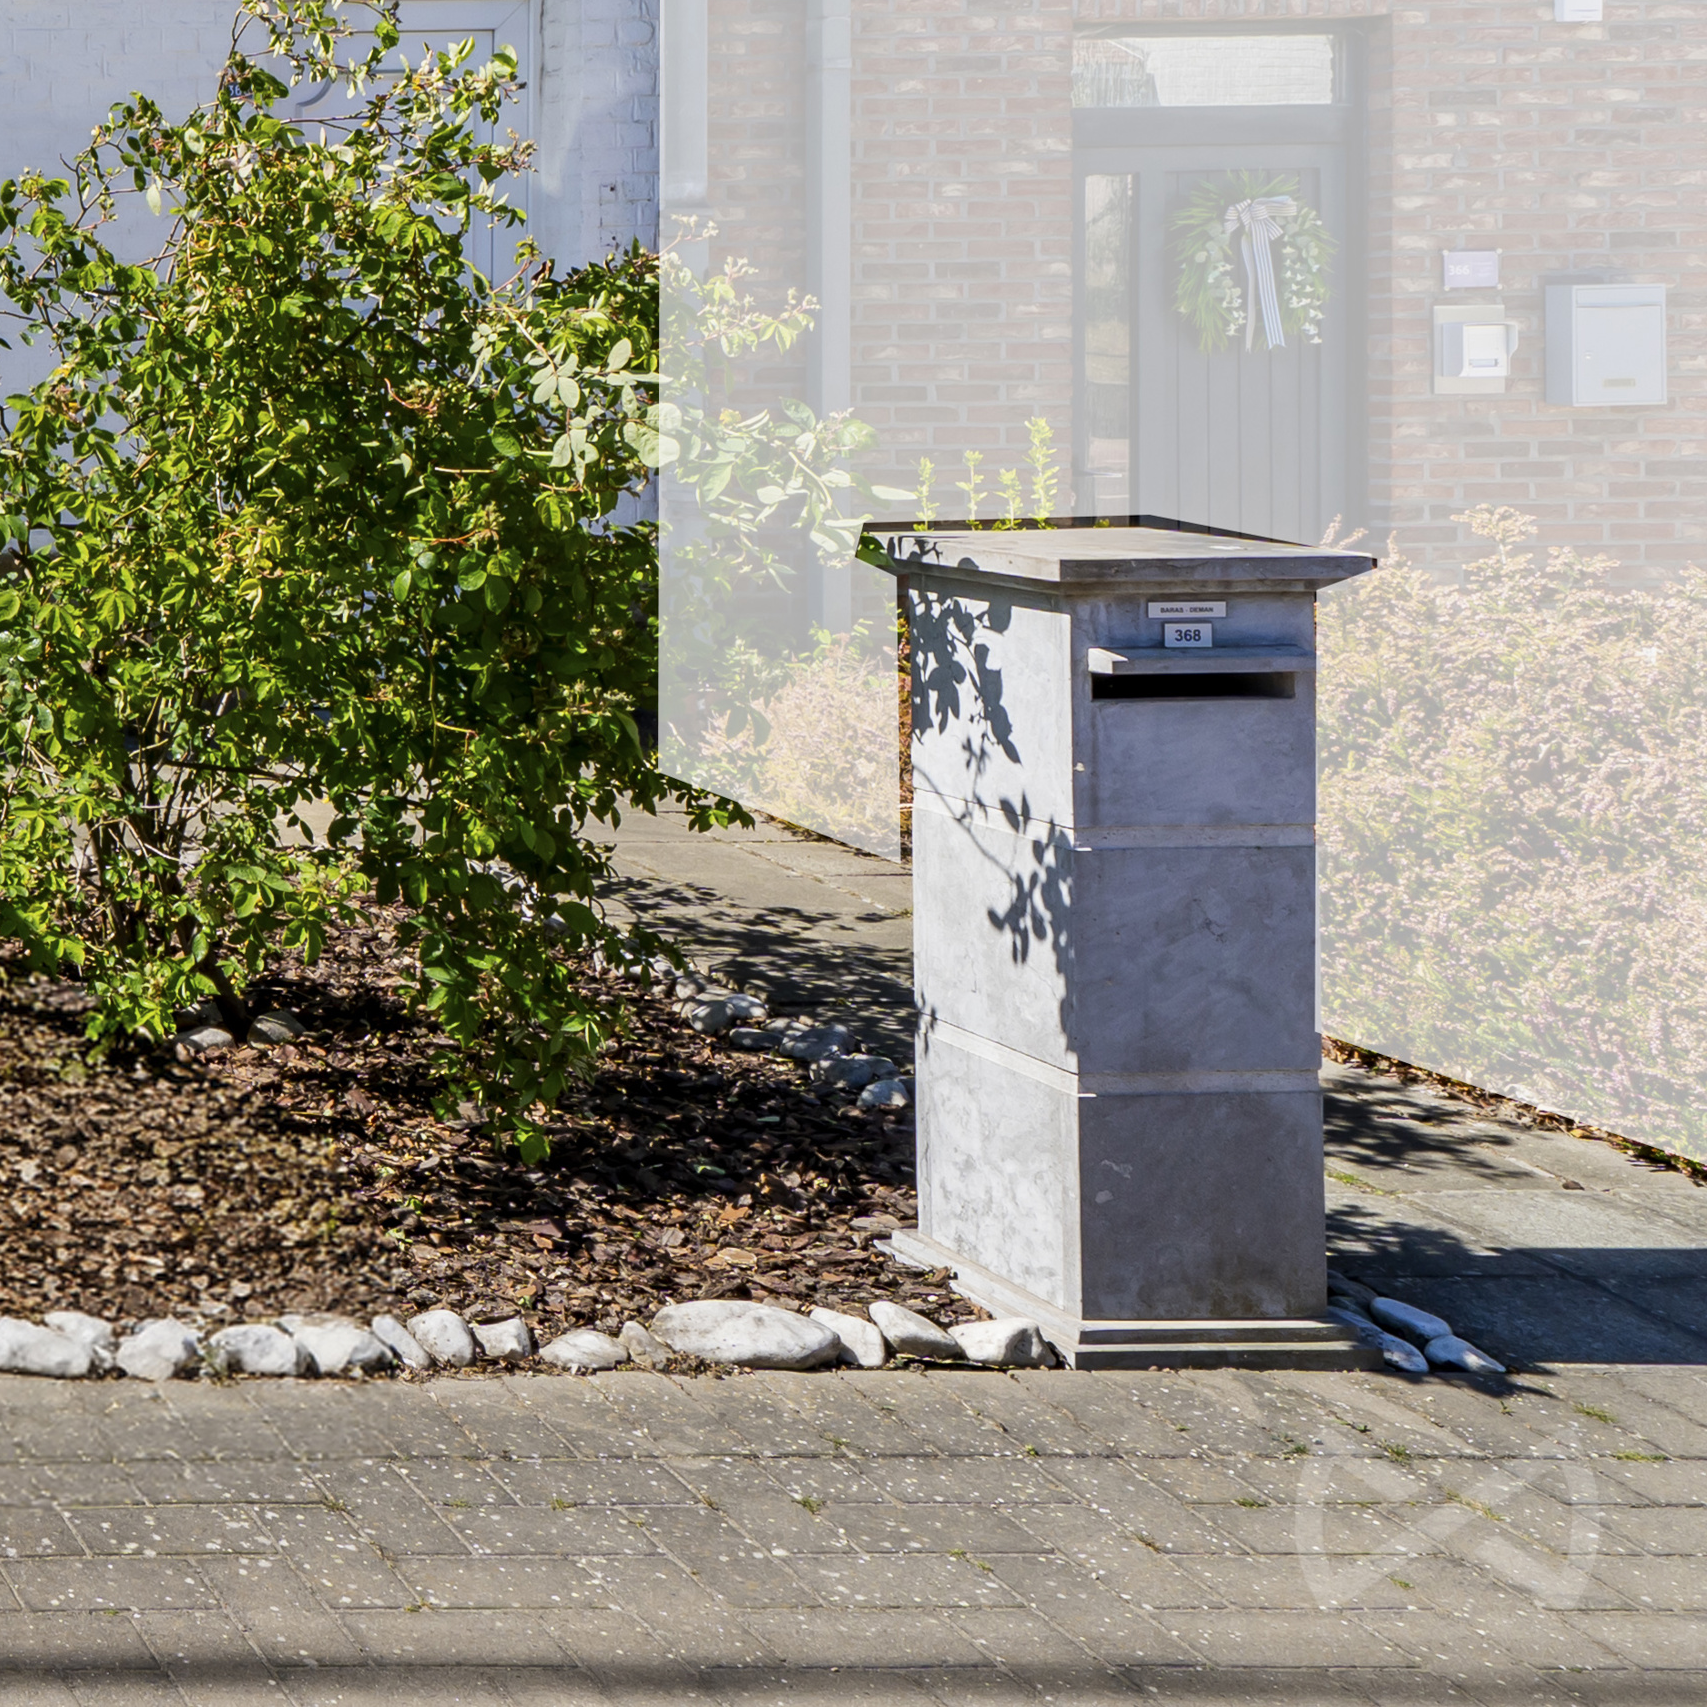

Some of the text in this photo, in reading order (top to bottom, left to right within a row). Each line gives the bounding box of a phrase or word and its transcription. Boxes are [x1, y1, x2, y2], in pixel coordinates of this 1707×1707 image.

[228, 84, 249, 97] 36
[1448, 264, 1470, 276] 366
[1174, 629, 1201, 642] 368
